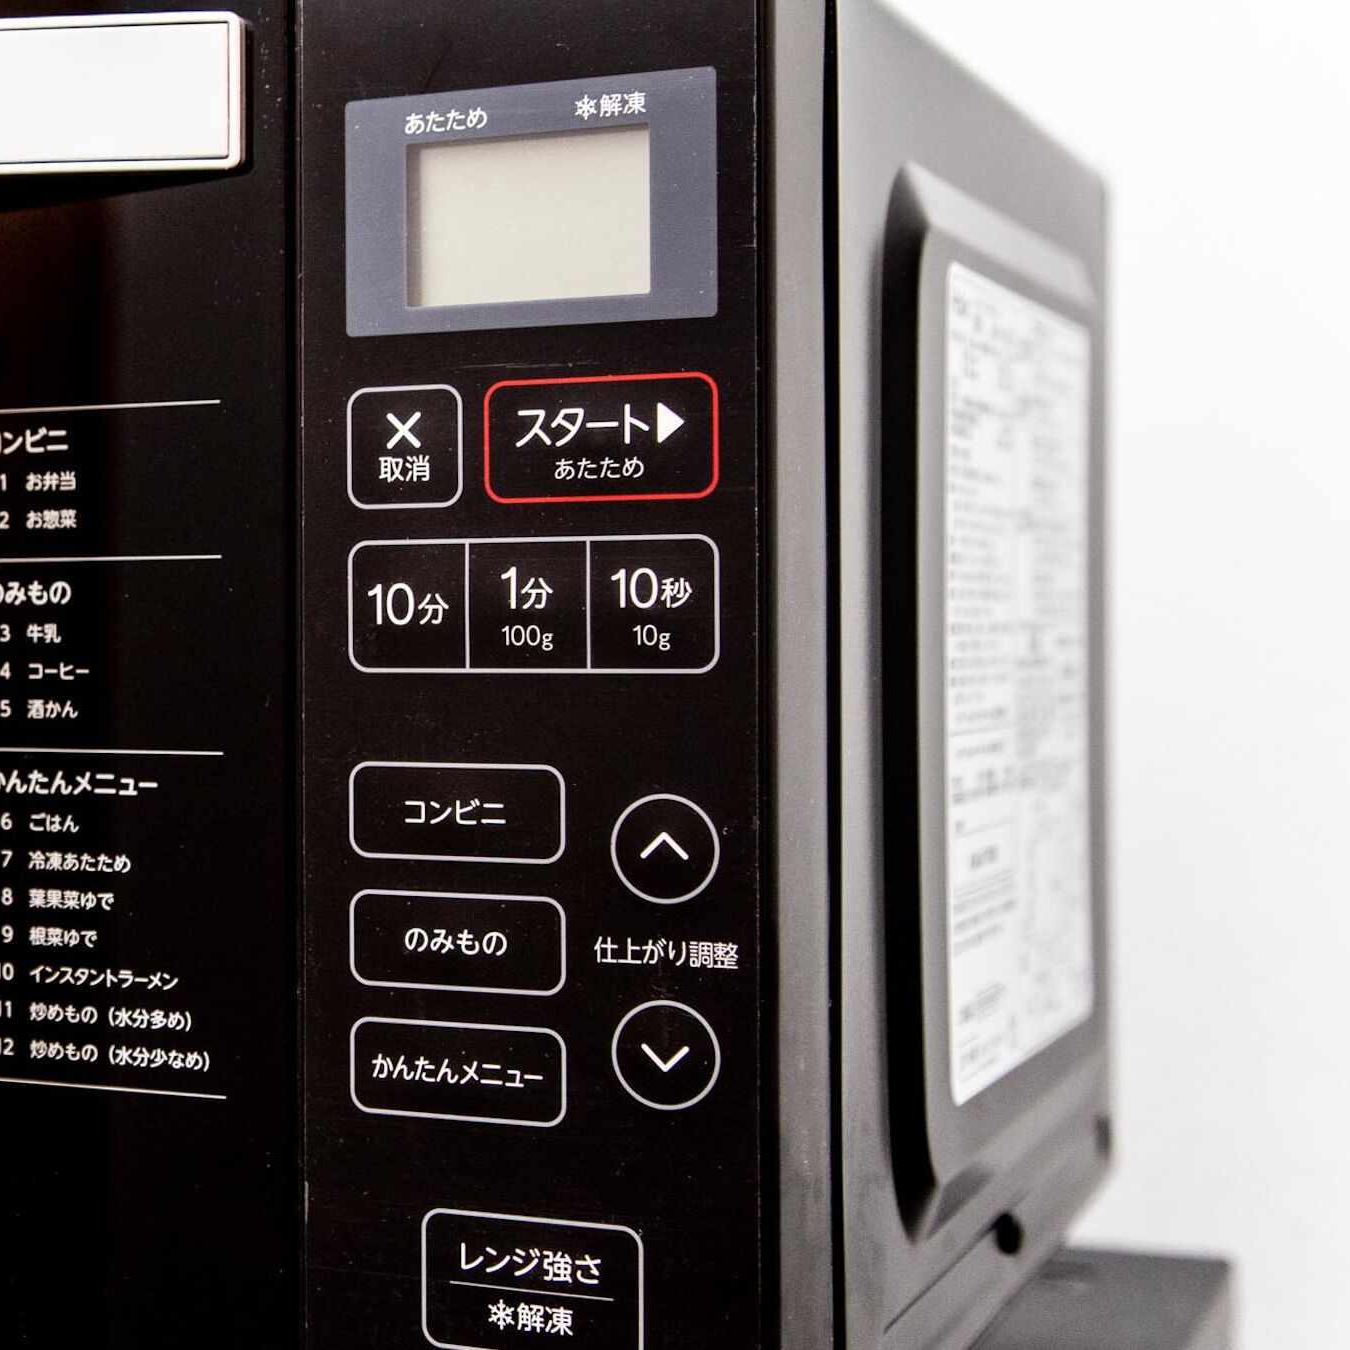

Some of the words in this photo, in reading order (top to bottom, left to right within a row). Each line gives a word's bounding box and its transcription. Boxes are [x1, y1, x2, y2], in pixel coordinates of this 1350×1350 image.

[599, 91, 646, 117] 解凍
[404, 106, 488, 135] あたため
[515, 403, 650, 448] スタート
[0, 473, 7, 492] 1
[25, 471, 76, 491] お弁当
[378, 454, 430, 483] 取消
[554, 455, 645, 481] あたため
[26, 509, 77, 529] お惣菜
[500, 566, 554, 610] 1分
[610, 567, 693, 609] 10秒
[367, 582, 450, 626] 10分
[0, 623, 11, 643] 3
[26, 623, 62, 644] 牛乳
[501, 624, 554, 652] 100g
[632, 624, 671, 651] 10g
[0, 661, 11, 680] 4
[28, 662, 90, 681] コーヒー
[0, 699, 12, 718] 5
[27, 699, 79, 719] 酒かん
[0, 812, 13, 831] 6
[29, 812, 80, 833] ごはん
[404, 798, 507, 825] コンビニ
[0, 849, 13, 868] 7
[28, 850, 132, 874] 冷凍あたため
[1, 887, 14, 906] 8
[29, 888, 115, 911] 葉果菜ゆで
[1, 924, 14, 944] 9
[29, 926, 98, 948] 根菜ゆで
[404, 927, 508, 956] のみもの
[593, 935, 739, 970] 仕上がり調整
[29, 965, 179, 991] インスタントラーメン
[371, 1053, 544, 1088] かんたんメニュー
[460, 1242, 602, 1285] レンジ強さ
[516, 1302, 574, 1336] 解凍
